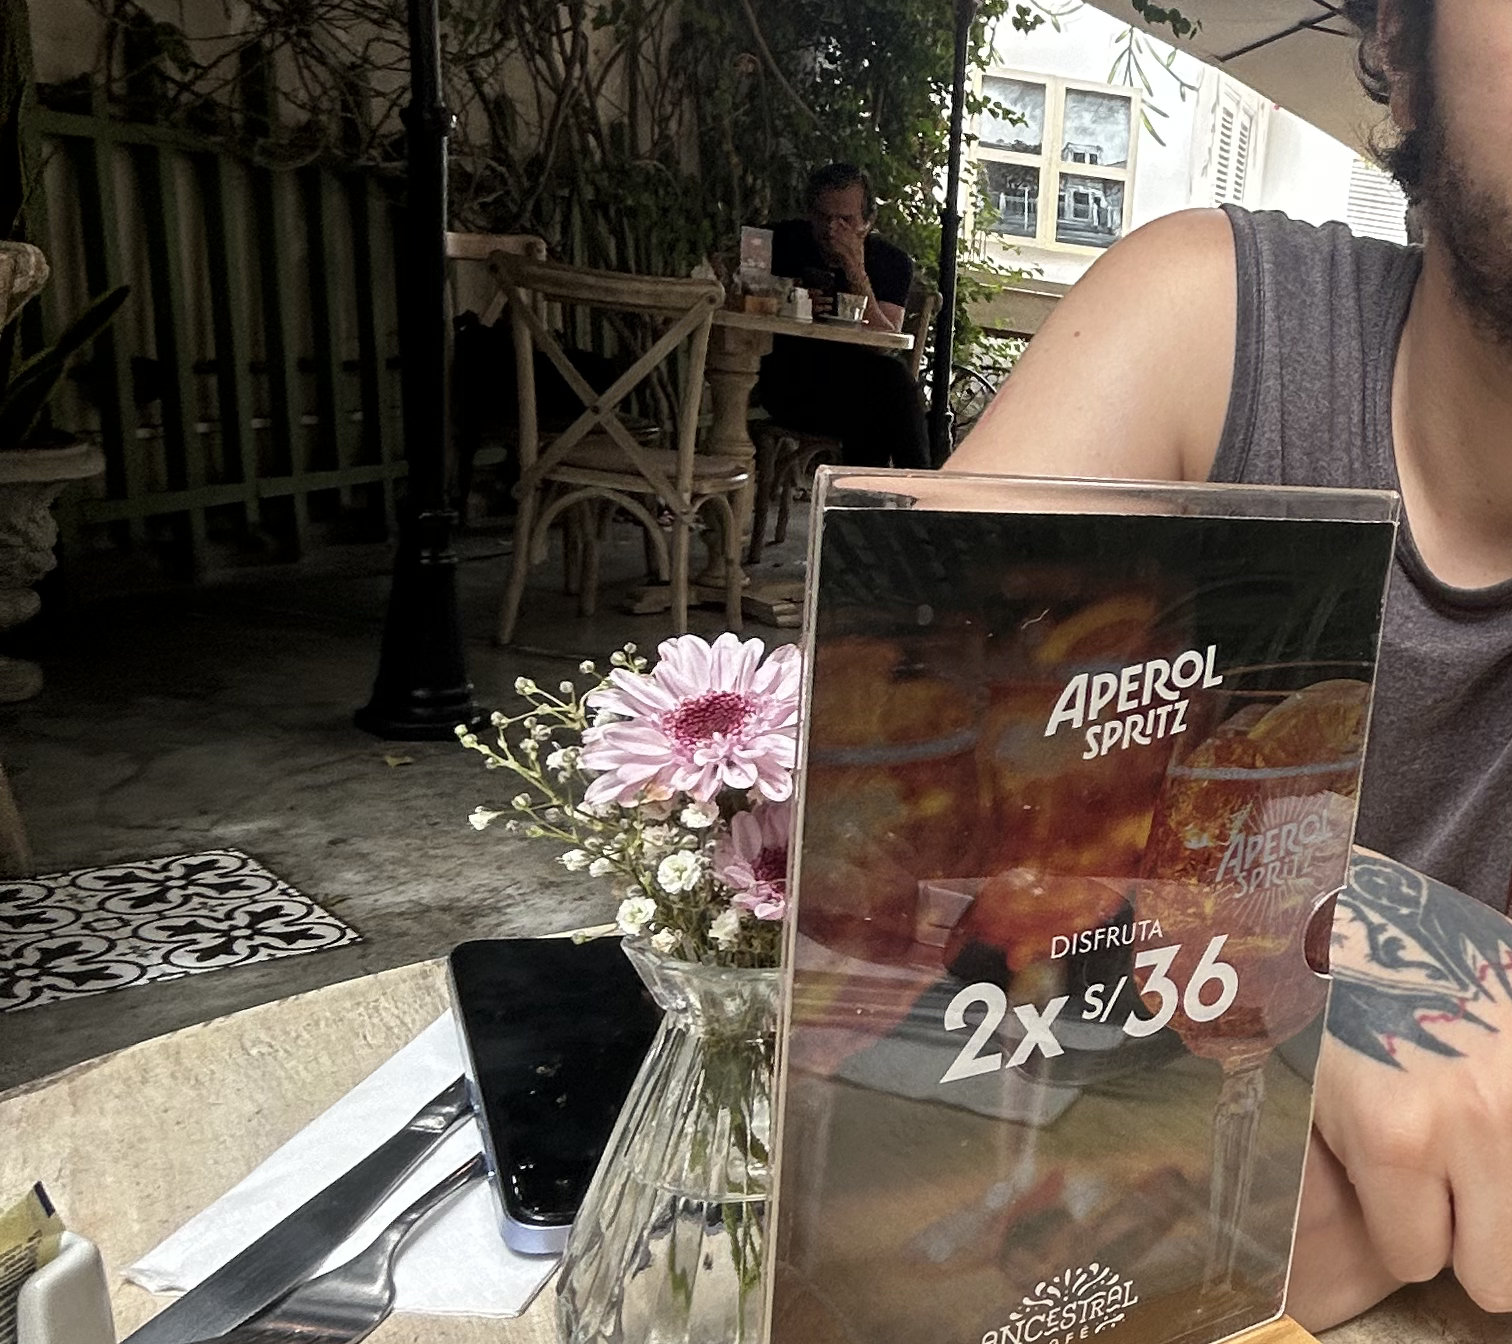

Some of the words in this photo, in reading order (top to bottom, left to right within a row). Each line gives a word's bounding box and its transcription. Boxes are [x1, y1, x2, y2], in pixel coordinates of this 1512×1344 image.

[1044, 644, 1223, 737] APEROL
[1082, 699, 1190, 760] SPRITZ
[1215, 809, 1333, 883] APEROL
[1050, 919, 1163, 960] DISFRUTA
[939, 981, 1070, 1084] 2x
